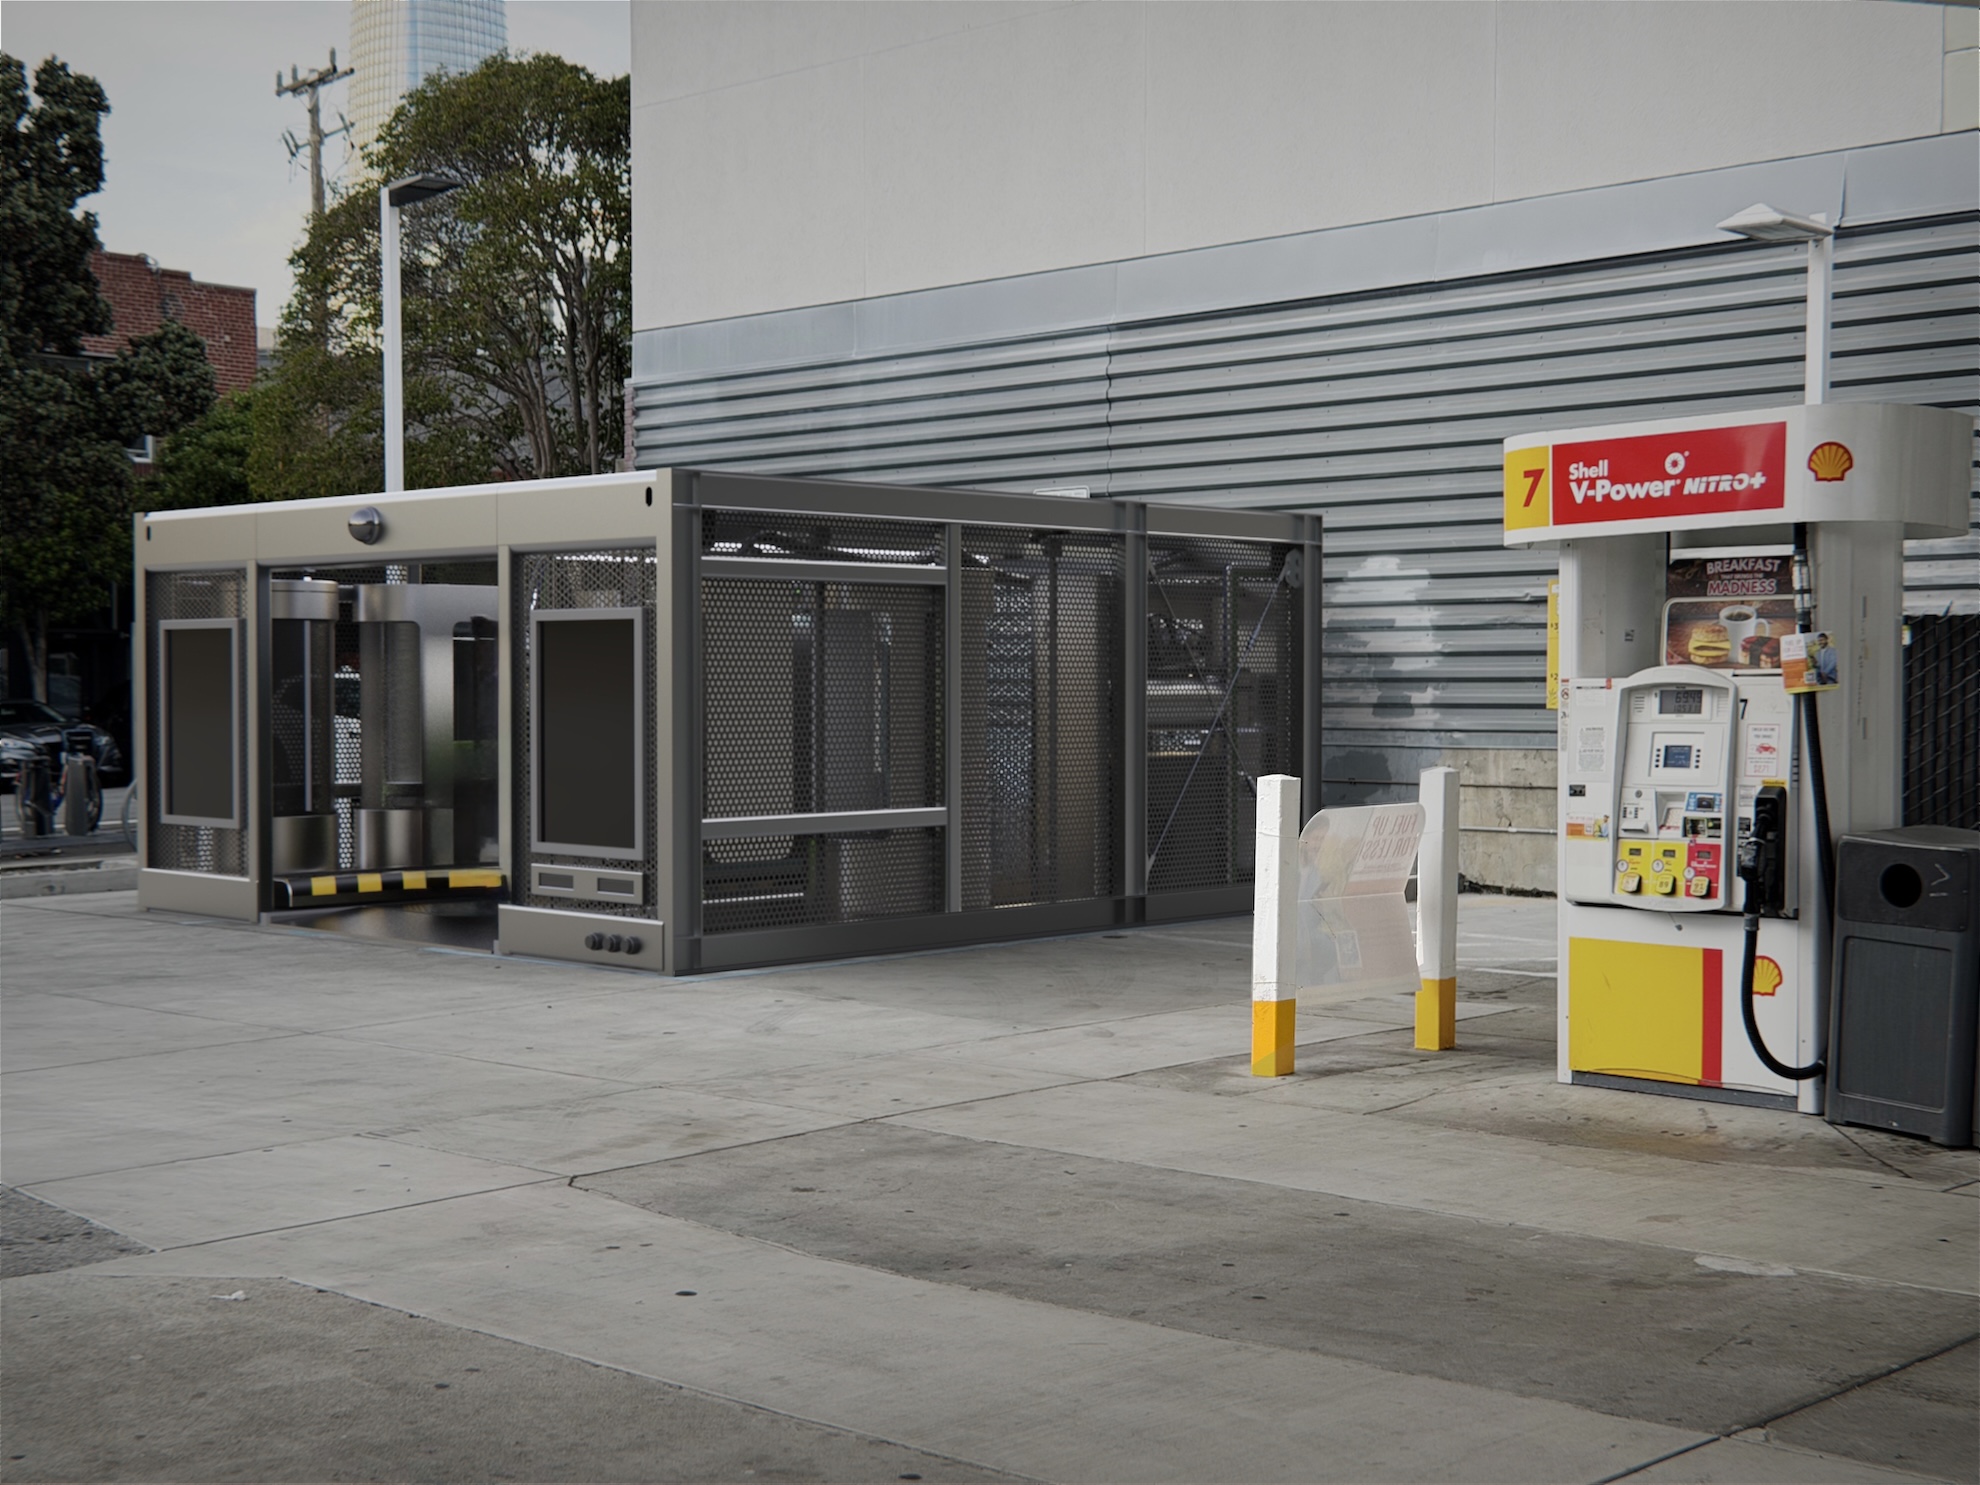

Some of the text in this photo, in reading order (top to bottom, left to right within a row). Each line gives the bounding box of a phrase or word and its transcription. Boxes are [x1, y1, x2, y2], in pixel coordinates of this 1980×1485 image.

[1568, 458, 1608, 480] Shell
[1523, 468, 1545, 508] 7
[1568, 478, 1677, 504] V-Power
[1706, 558, 1781, 575] BREAKFAST
[1707, 578, 1776, 596] MADNESS
[1739, 698, 1748, 719] 7
